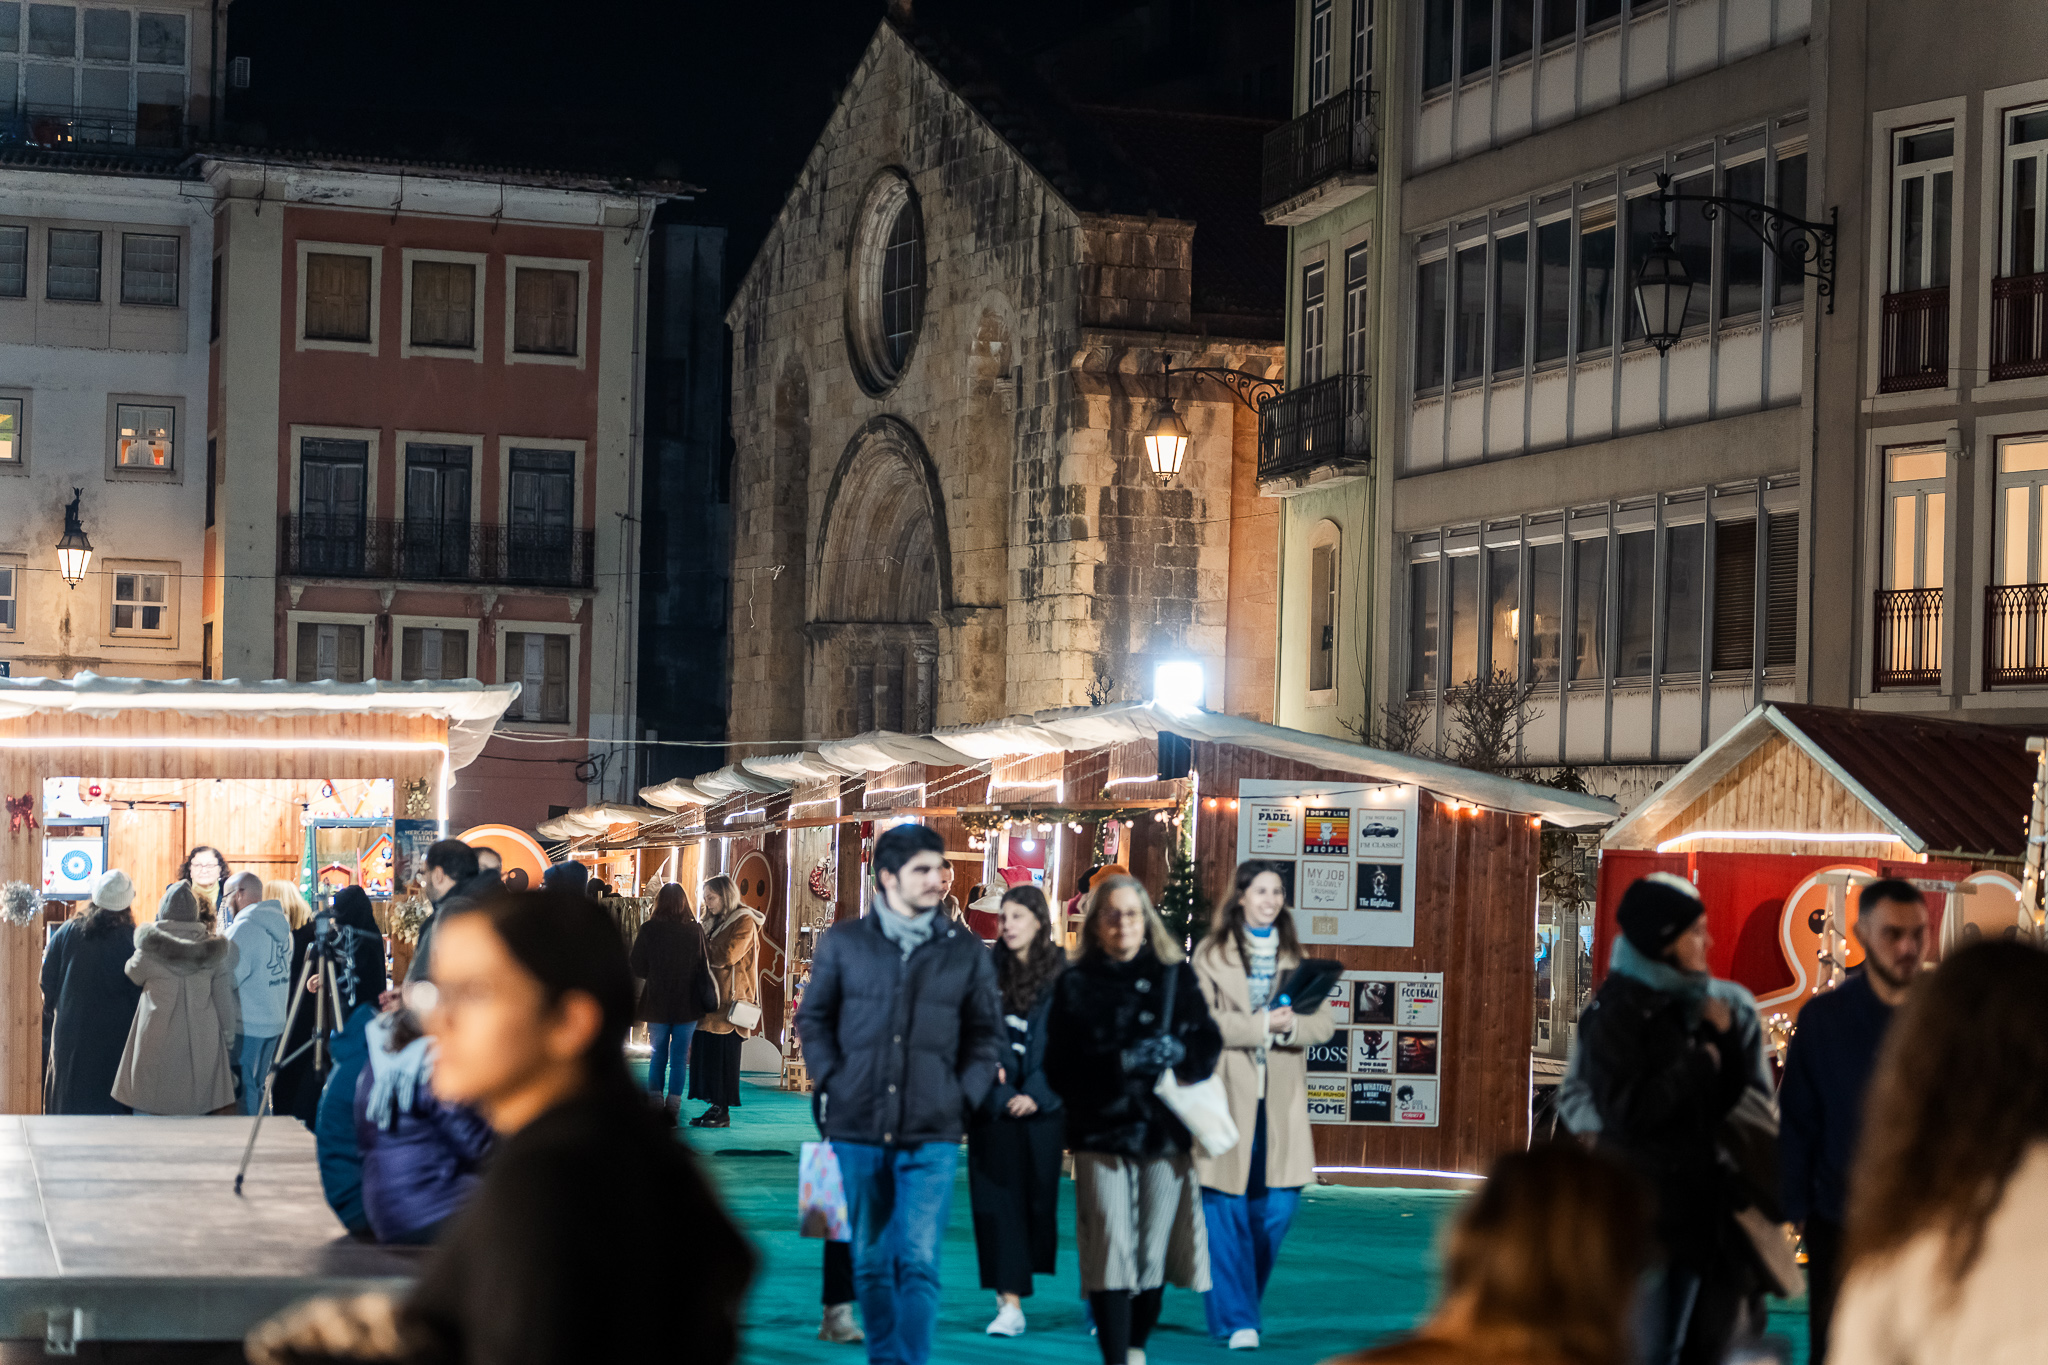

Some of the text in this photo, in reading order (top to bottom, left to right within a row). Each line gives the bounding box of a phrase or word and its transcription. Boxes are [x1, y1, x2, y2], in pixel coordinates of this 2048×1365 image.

[1258, 812, 1292, 821] PADEL
[1307, 867, 1345, 881] MY JOB
[1316, 880, 1342, 888] SLOWLY
[1359, 897, 1370, 906] The
[1401, 987, 1438, 999] FOOTBALL
[1306, 1045, 1348, 1061] BOSS
[1307, 1103, 1346, 1115] FOME
